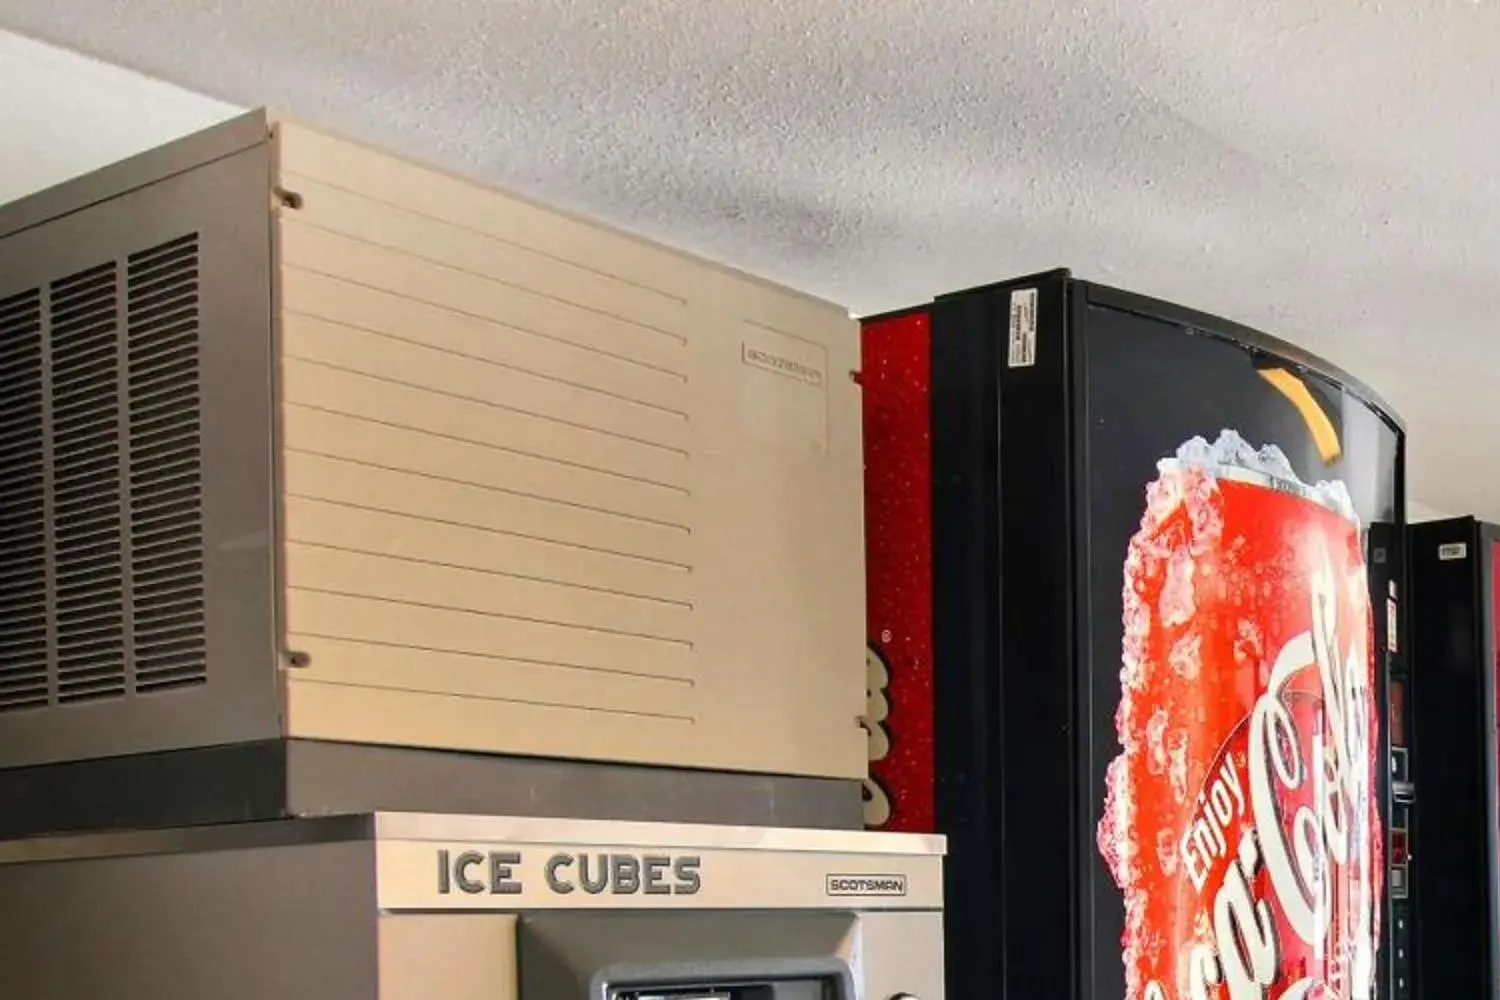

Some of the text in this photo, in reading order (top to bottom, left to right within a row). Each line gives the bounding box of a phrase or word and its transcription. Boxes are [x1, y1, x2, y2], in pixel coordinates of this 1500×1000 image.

[1180, 749, 1247, 894] Enjoy
[437, 849, 701, 895] ICE CUBES
[830, 879, 903, 891] SCOTSMAN
